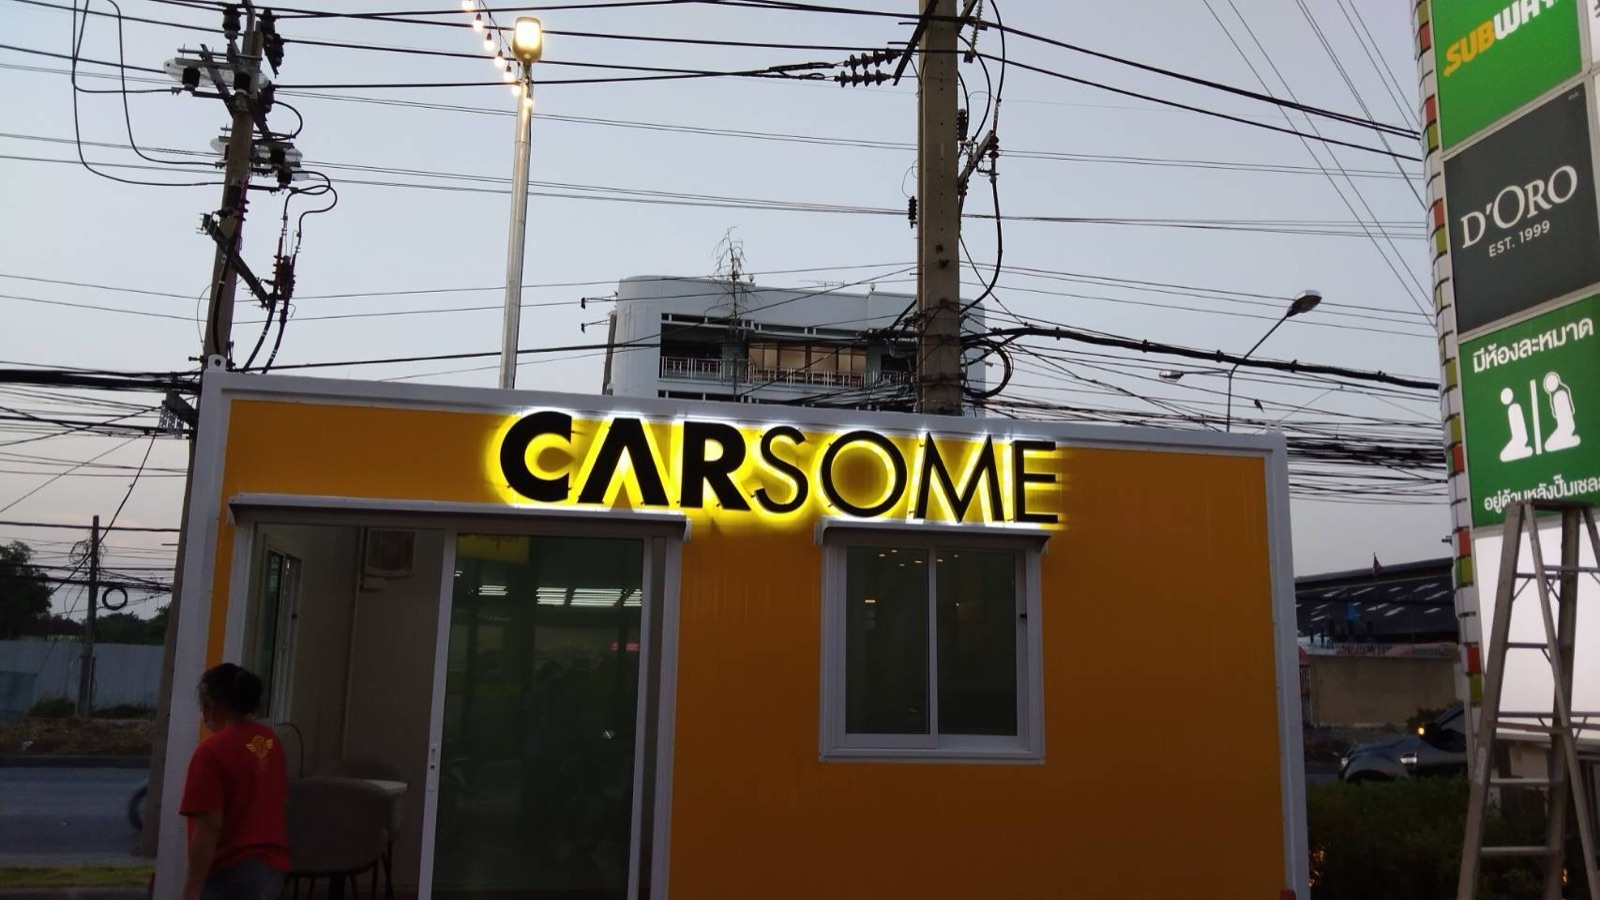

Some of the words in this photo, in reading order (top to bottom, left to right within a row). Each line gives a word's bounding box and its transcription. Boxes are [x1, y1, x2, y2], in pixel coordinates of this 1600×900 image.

[1460, 165, 1578, 249] D'ORO
[1488, 236, 1515, 258] EST.
[1519, 220, 1550, 244] 1999
[1472, 317, 1594, 373] มีห้องละหมาด
[499, 411, 1059, 524] CARSOME
